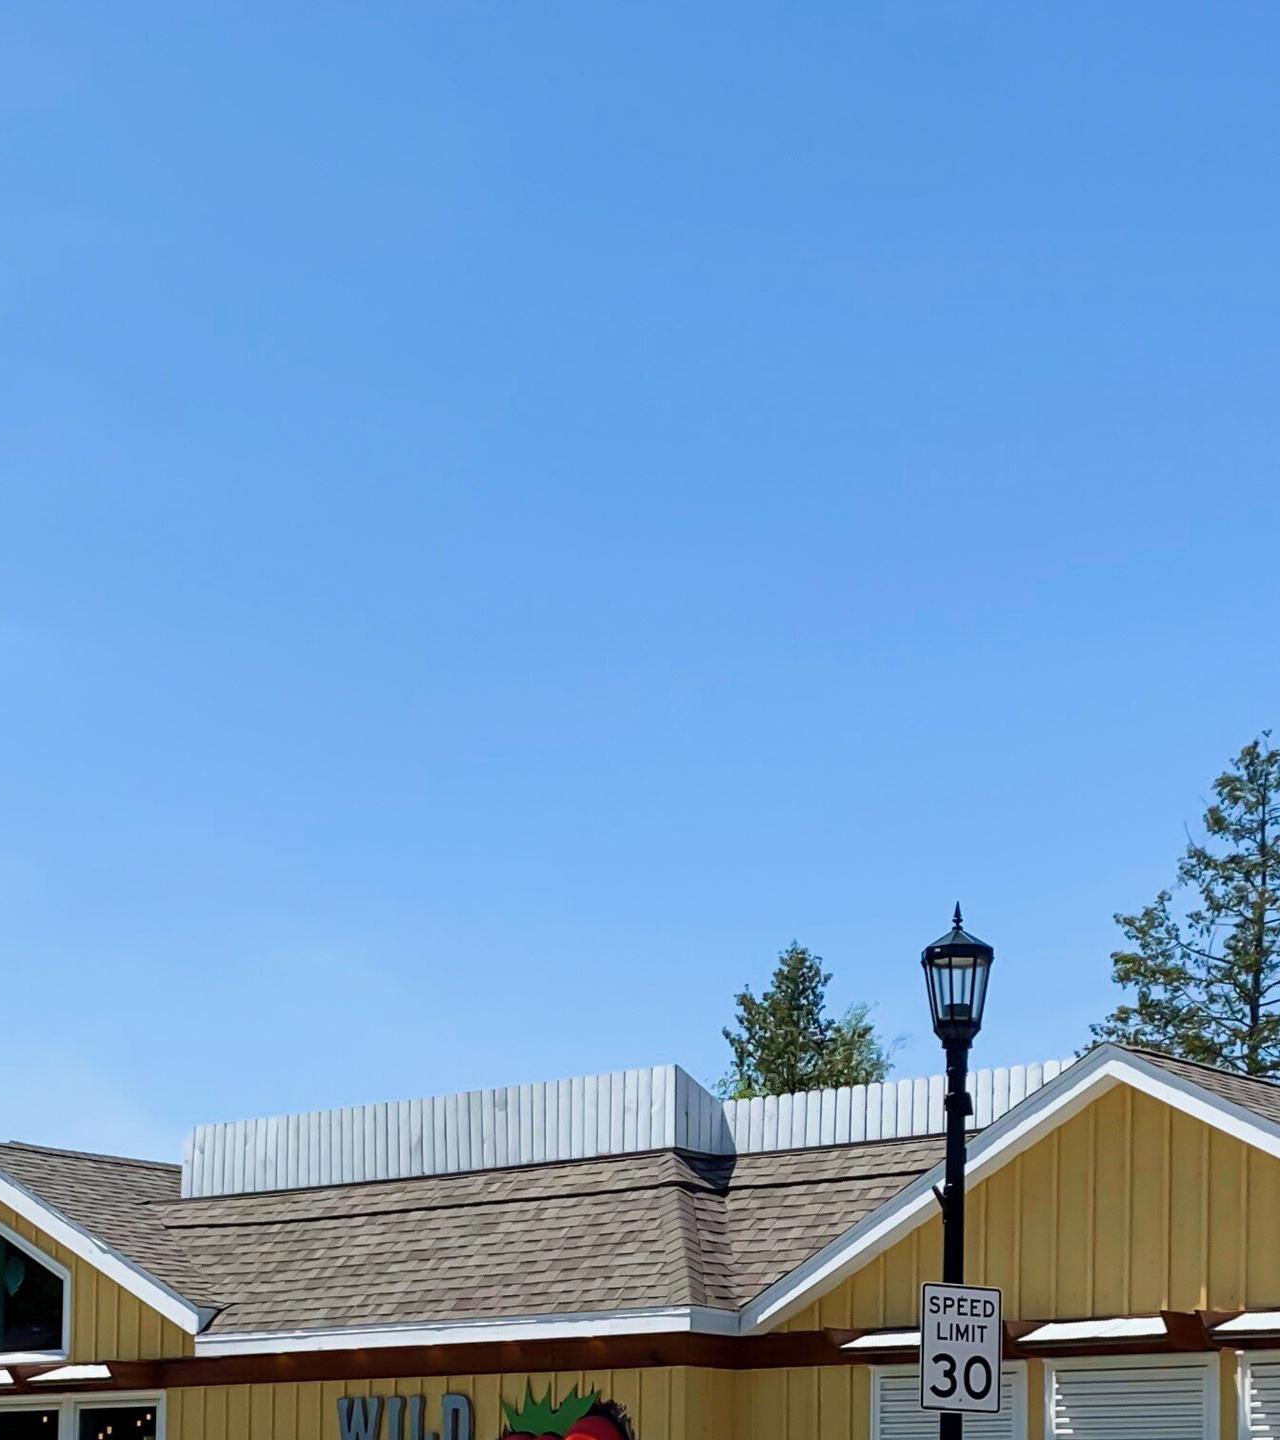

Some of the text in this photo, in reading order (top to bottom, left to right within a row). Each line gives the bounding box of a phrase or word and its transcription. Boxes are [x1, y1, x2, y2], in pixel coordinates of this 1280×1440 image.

[929, 1296, 995, 1318] SPEED
[937, 1322, 988, 1343] LIMIT
[929, 1353, 992, 1400] 30
